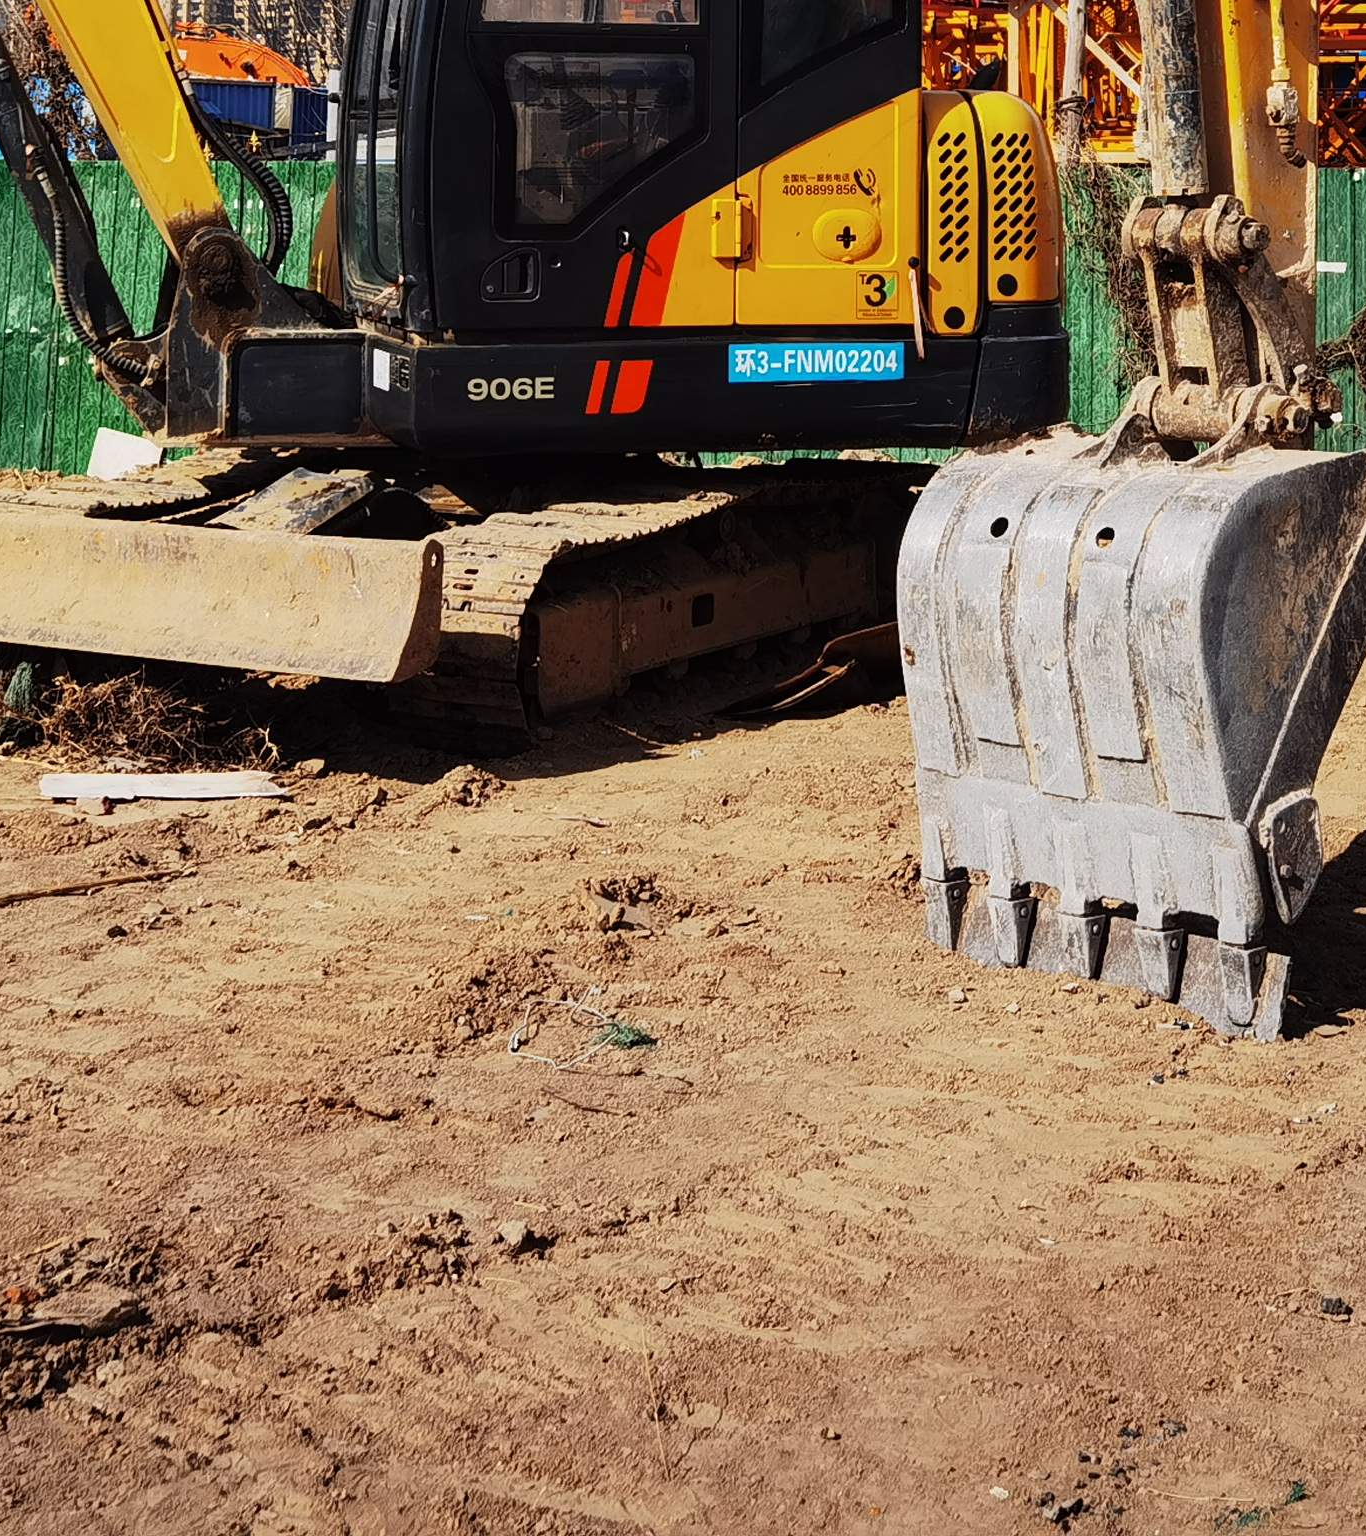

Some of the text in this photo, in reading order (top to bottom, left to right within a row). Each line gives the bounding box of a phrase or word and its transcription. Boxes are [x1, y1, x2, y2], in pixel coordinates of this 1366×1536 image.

[782, 173, 850, 184] 全国统一服务电话
[782, 183, 857, 196] 400 8899 856
[734, 349, 898, 377] 环3-FNM02204
[467, 376, 556, 401] 906E
